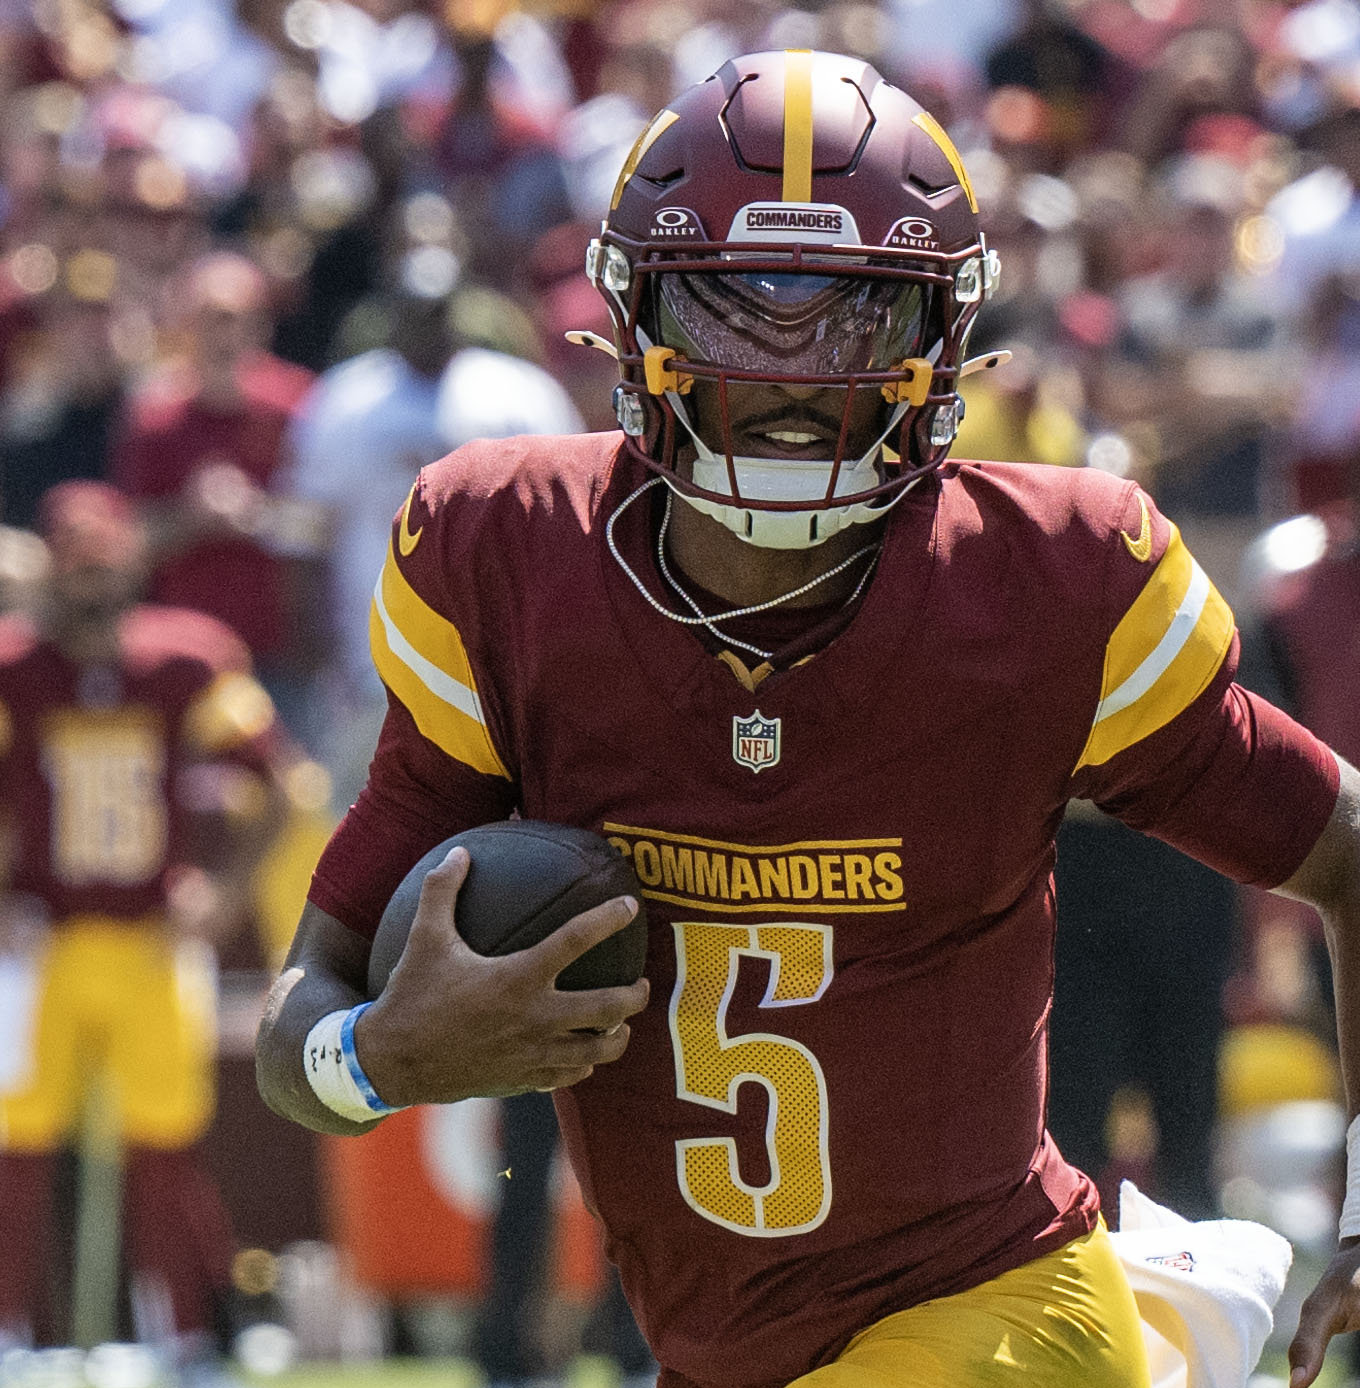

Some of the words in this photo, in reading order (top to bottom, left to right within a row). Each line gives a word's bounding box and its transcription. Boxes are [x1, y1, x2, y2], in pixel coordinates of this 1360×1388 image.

[746, 211, 842, 230] COMMANDERS
[651, 227, 696, 236] OAKLEY
[892, 236, 939, 249] OAKLEY
[740, 739, 773, 762] NFL
[669, 922, 834, 1238] 5
